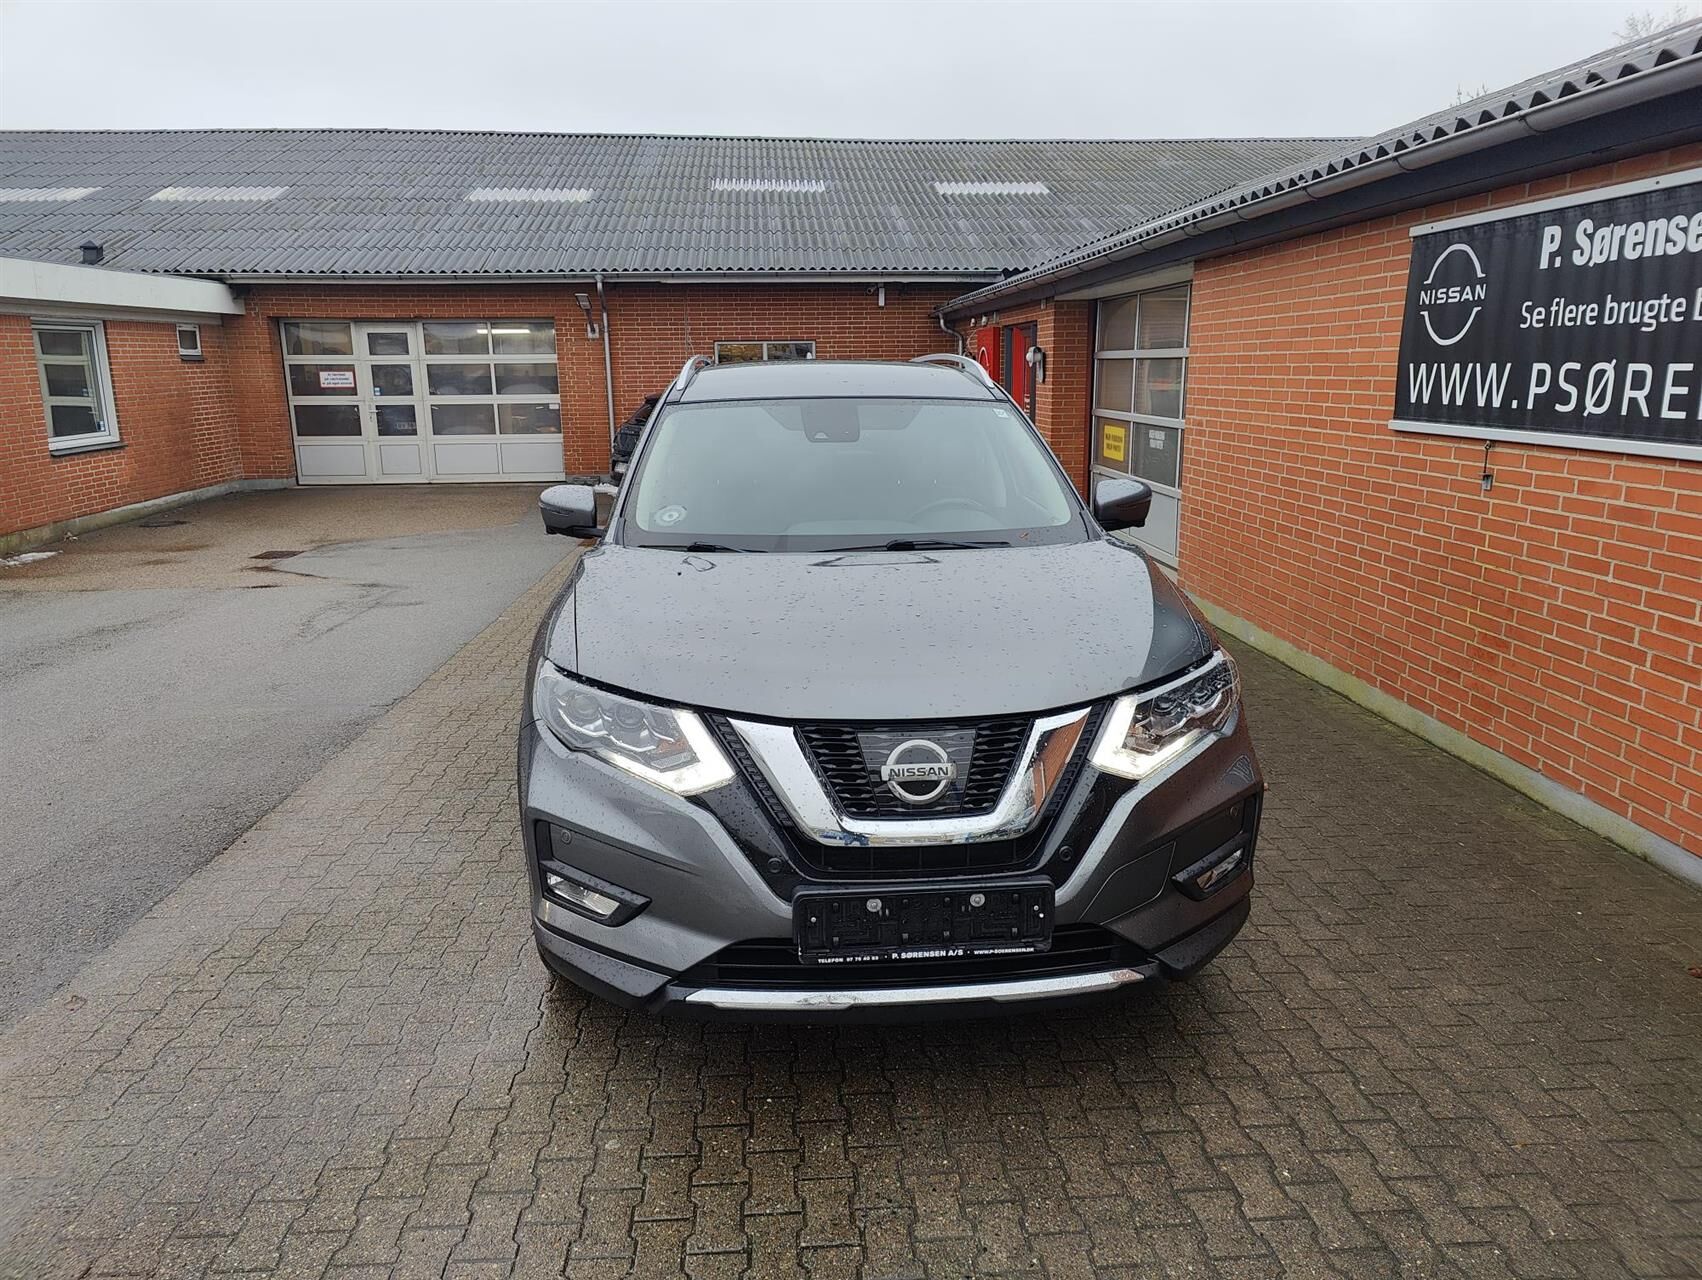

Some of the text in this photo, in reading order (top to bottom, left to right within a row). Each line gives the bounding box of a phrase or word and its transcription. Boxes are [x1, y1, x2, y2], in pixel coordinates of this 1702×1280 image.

[1539, 225, 1562, 269] P.
[1419, 284, 1486, 305] NISSAN
[1519, 301, 1544, 329] Se
[1549, 297, 1599, 327] flere
[1603, 293, 1687, 332] brugte
[1409, 359, 1702, 420] WWW.PSØRE
[889, 767, 949, 778] NISSAN
[901, 951, 946, 959] SØRENSEN
